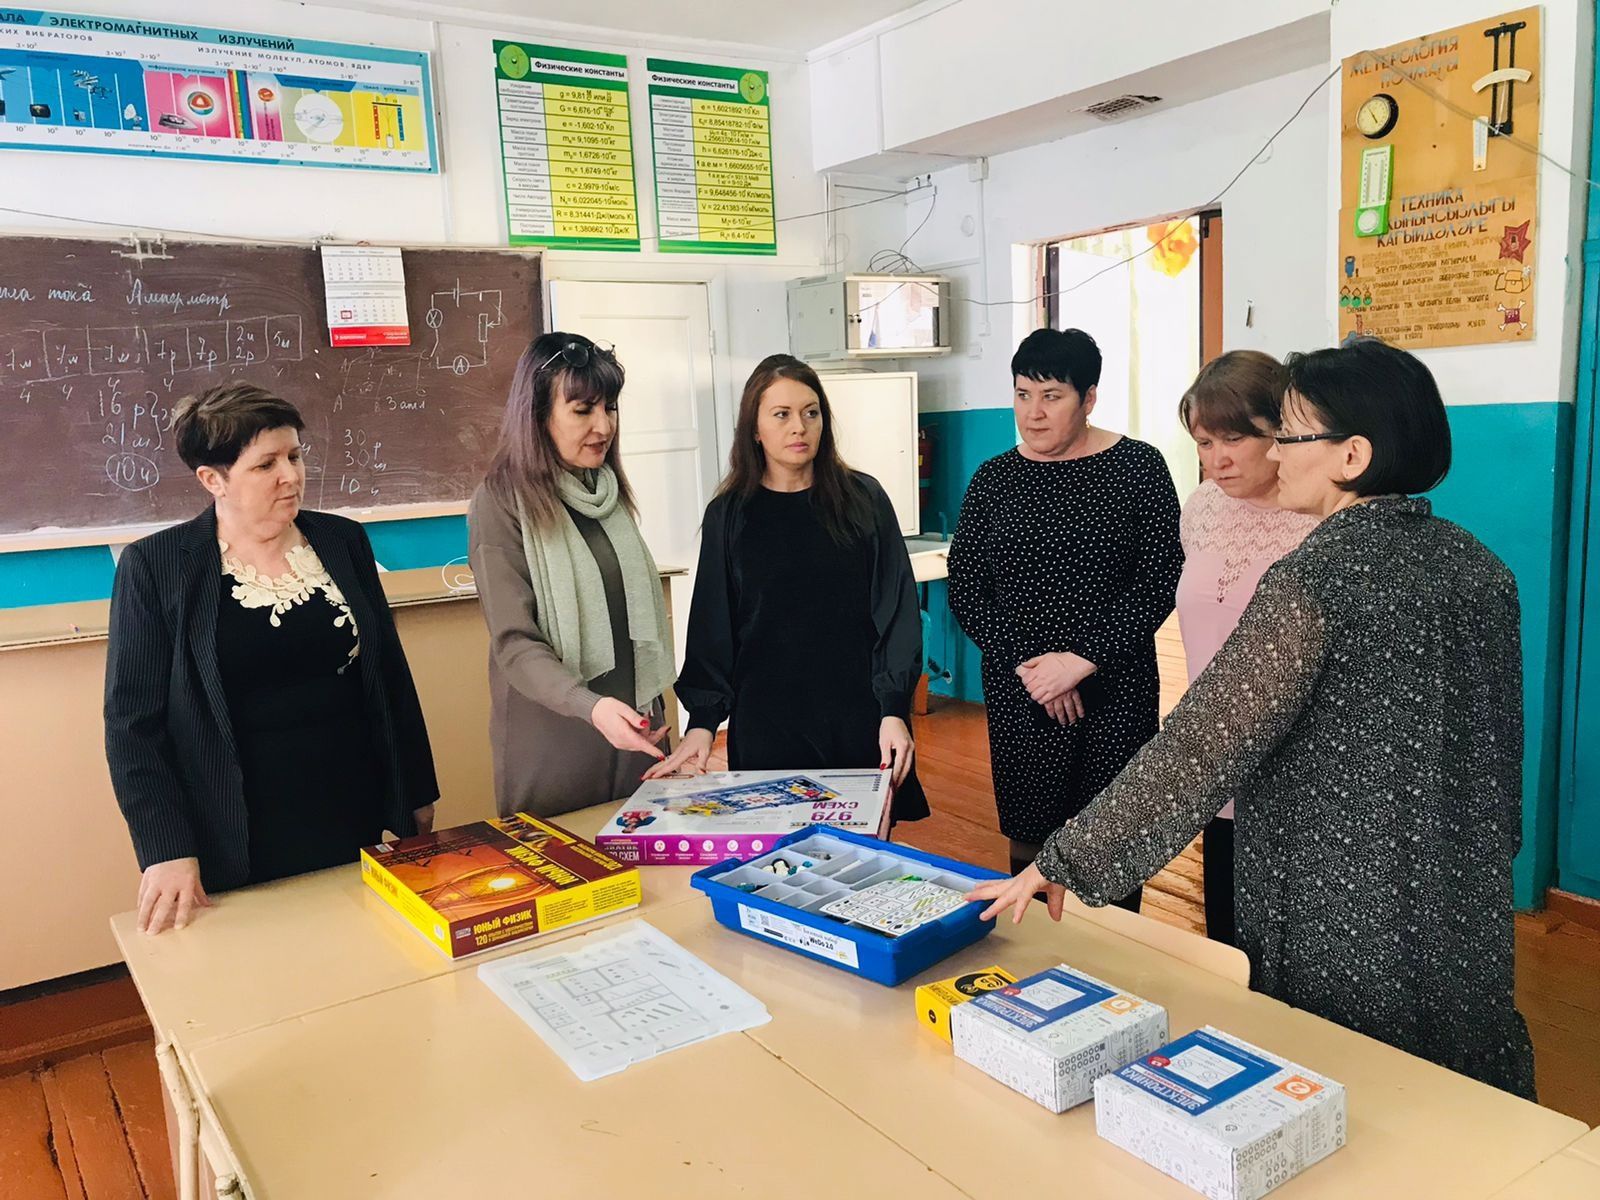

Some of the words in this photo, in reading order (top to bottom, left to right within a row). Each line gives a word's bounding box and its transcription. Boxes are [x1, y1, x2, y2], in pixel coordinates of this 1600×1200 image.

[25, 29, 94, 42] ВИБРАТОРОВ
[49, 16, 198, 40] ЭЛЕКТРОМАГНИТНЫХ
[218, 34, 295, 51] ИЗЛУЧЕНИЙ
[197, 46, 253, 58] ИЗЛУЧЕНИЕ
[534, 60, 584, 75] Физические
[584, 67, 625, 78] константы
[651, 74, 697, 86] Физические
[697, 79, 736, 90] константы
[1400, 187, 1464, 213] ТЕХНИКА
[812, 801, 859, 810] СХЕМ
[811, 811, 854, 822] 979
[473, 916, 502, 935] ЮНЫЙ
[502, 909, 533, 926] ФИЗИК
[475, 934, 488, 946] 120
[1120, 1067, 1201, 1111] ЭЛЕКТРОНИКА
